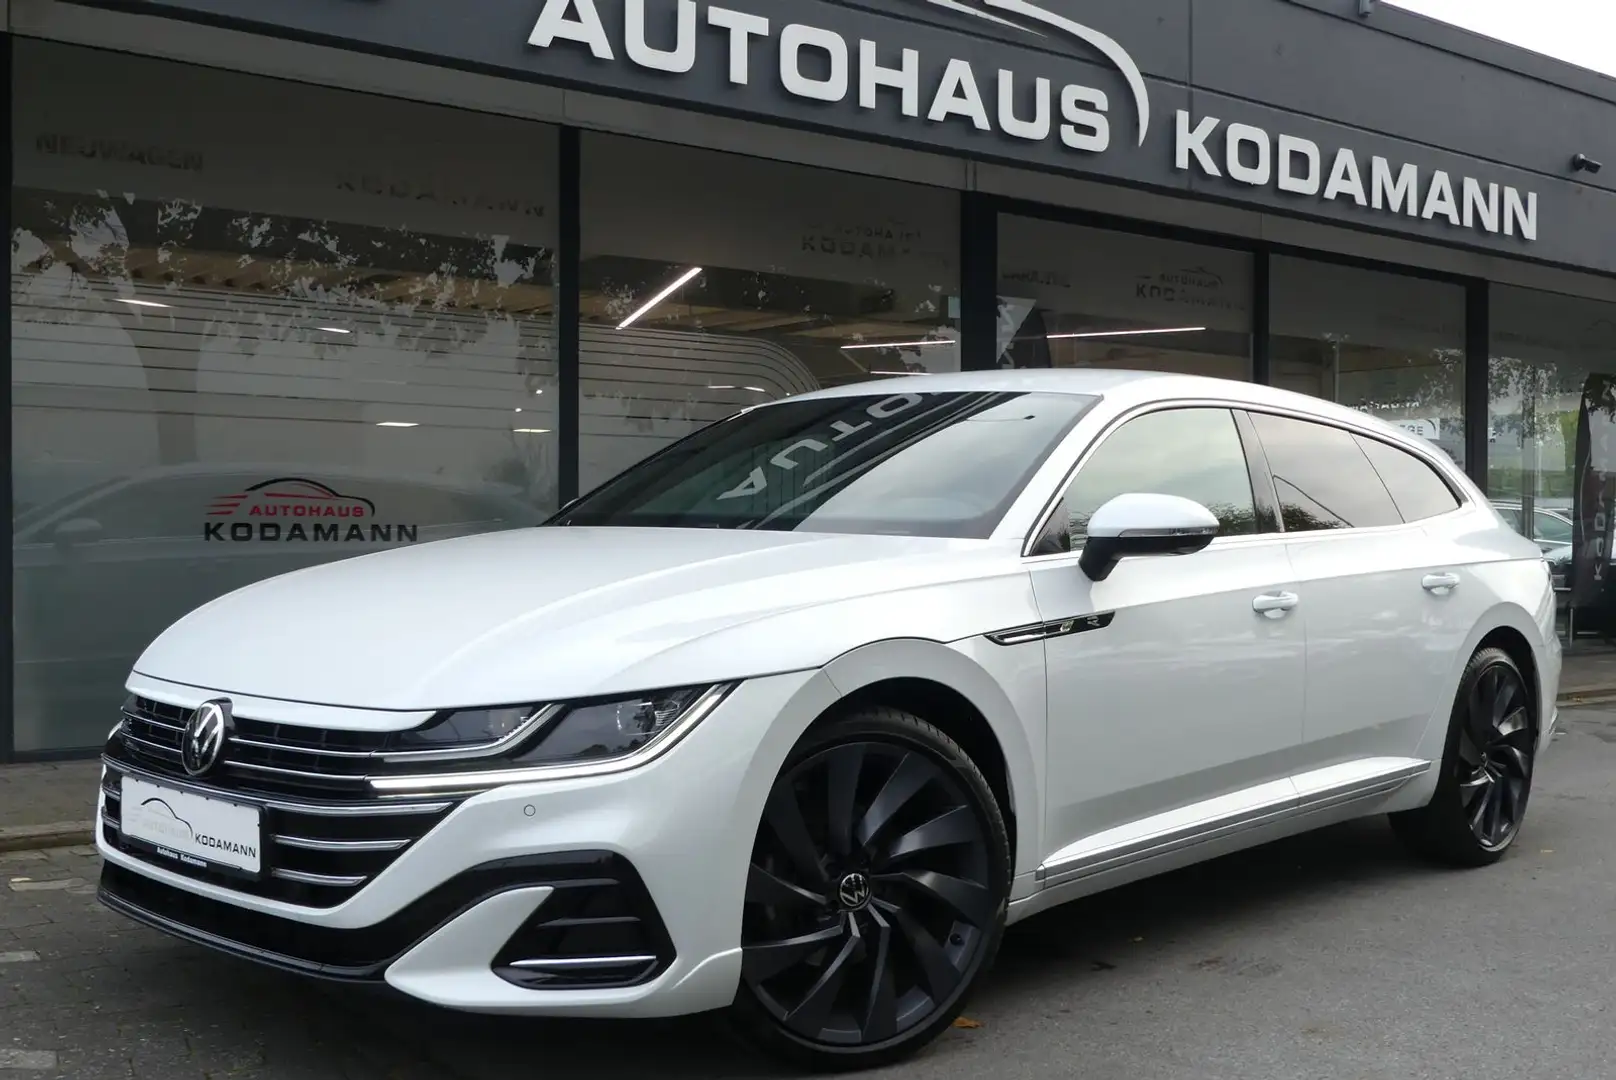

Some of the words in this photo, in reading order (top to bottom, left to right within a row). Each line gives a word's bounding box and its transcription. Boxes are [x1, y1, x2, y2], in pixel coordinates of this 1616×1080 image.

[527, 0, 1110, 153] AUTOHAUS
[1175, 109, 1538, 241] KODAMANN
[248, 504, 364, 518] AUTOHAUS
[204, 521, 418, 543] KODAMANN
[195, 833, 257, 858] KODAMANN
